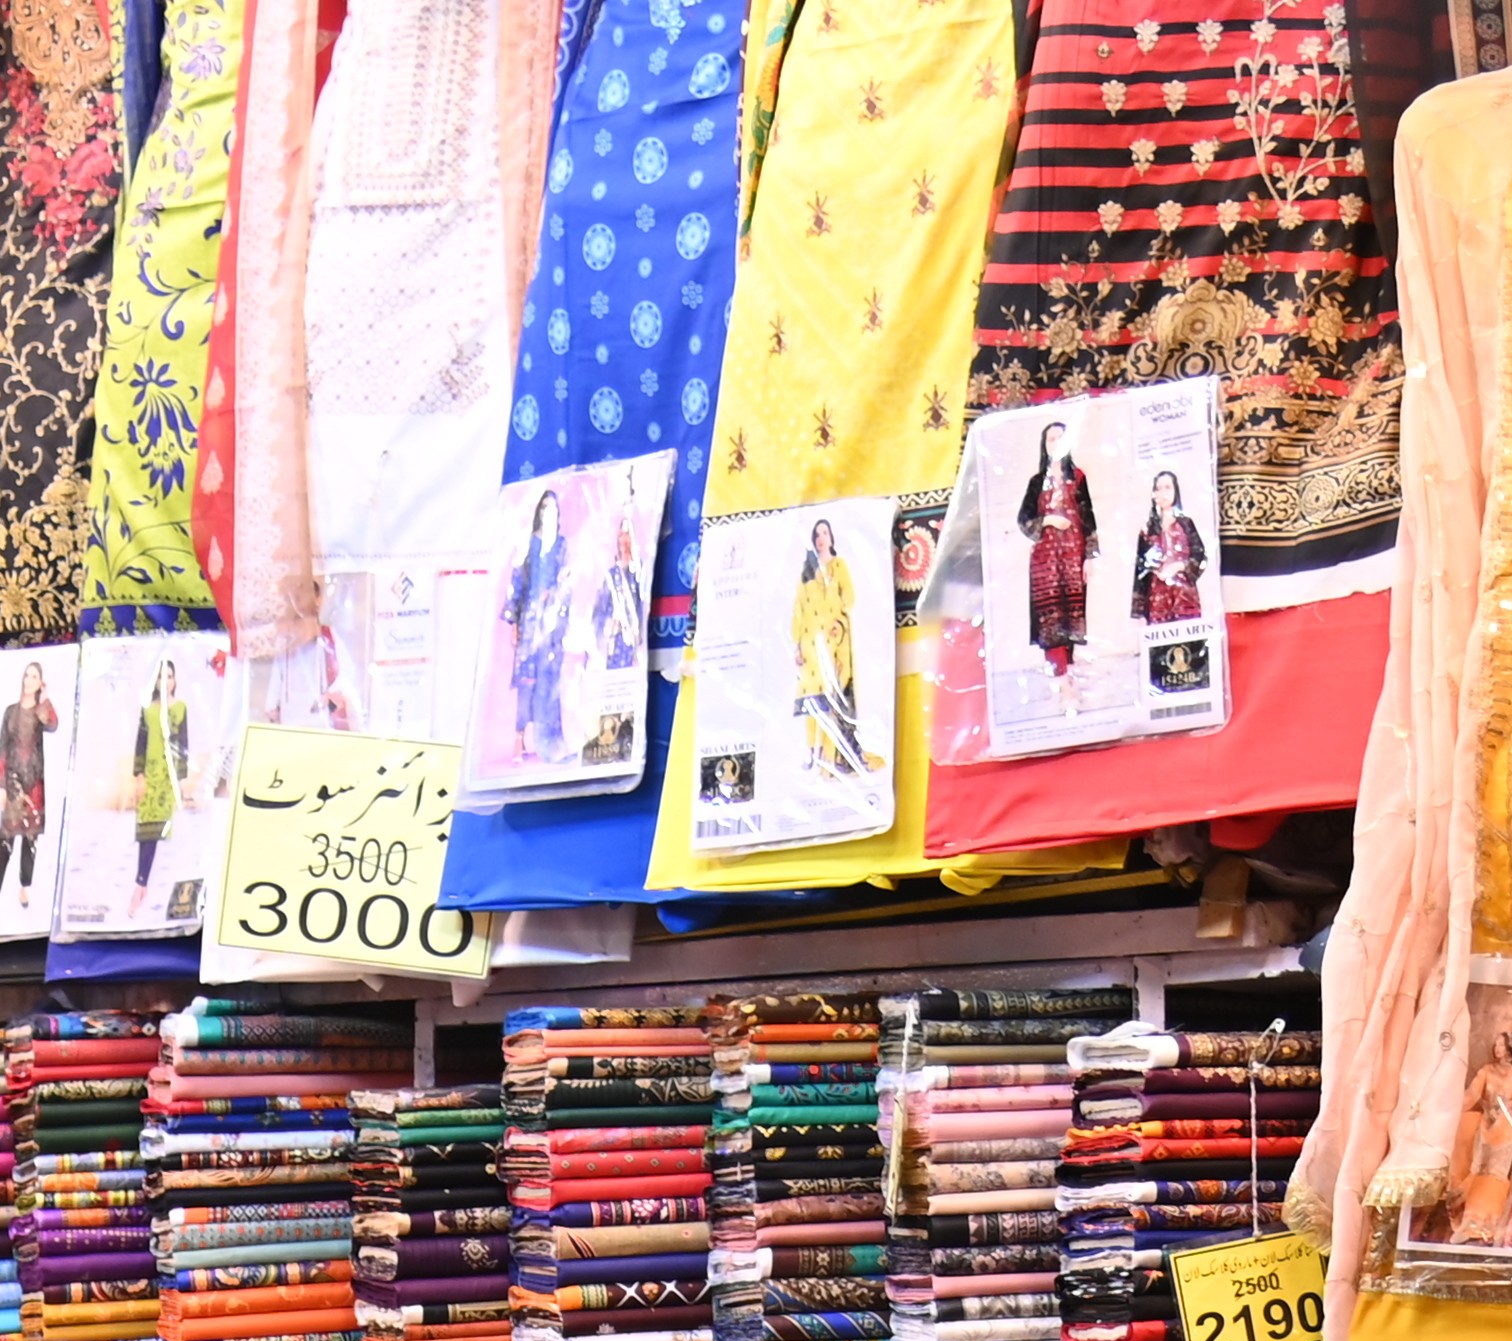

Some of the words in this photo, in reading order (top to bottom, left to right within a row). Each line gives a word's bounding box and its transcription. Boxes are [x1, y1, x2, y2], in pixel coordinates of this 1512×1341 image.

[306, 832, 409, 887] 3500
[238, 880, 474, 959] 3000
[1232, 1270, 1282, 1299] 2500
